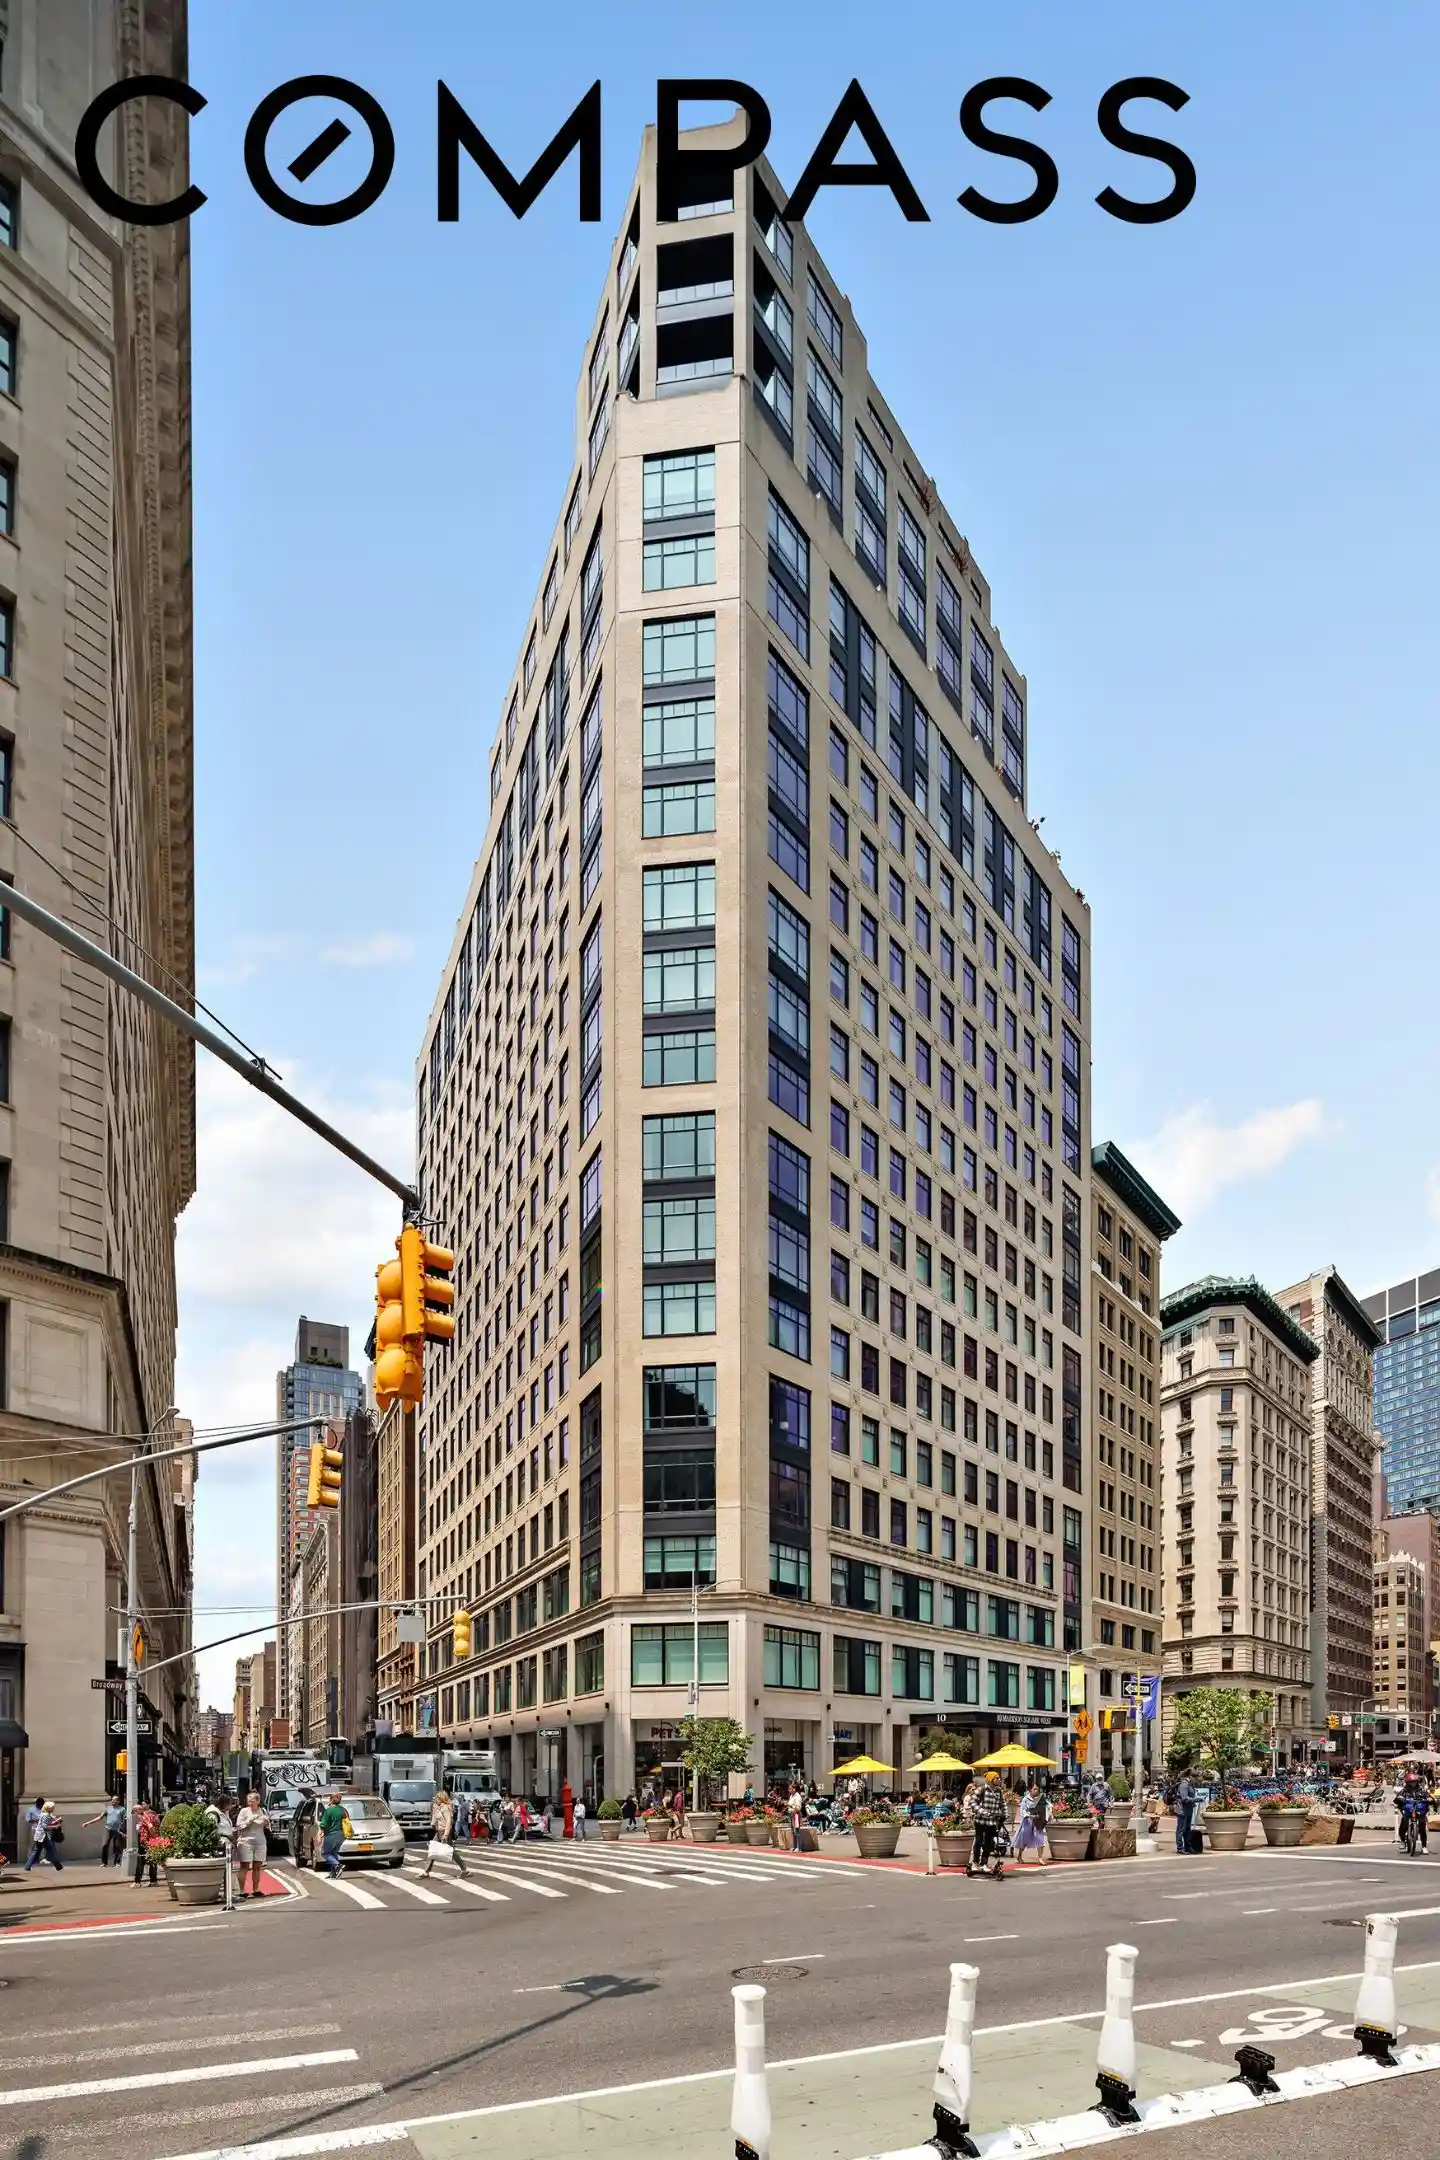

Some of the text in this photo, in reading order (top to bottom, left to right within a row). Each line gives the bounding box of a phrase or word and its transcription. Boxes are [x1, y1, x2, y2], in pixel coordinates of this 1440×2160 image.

[92, 1680, 123, 1690] Broadway
[936, 1713, 947, 1722] 10
[1002, 1714, 1022, 1723] MADISON
[1023, 1716, 1040, 1724] SQUARE
